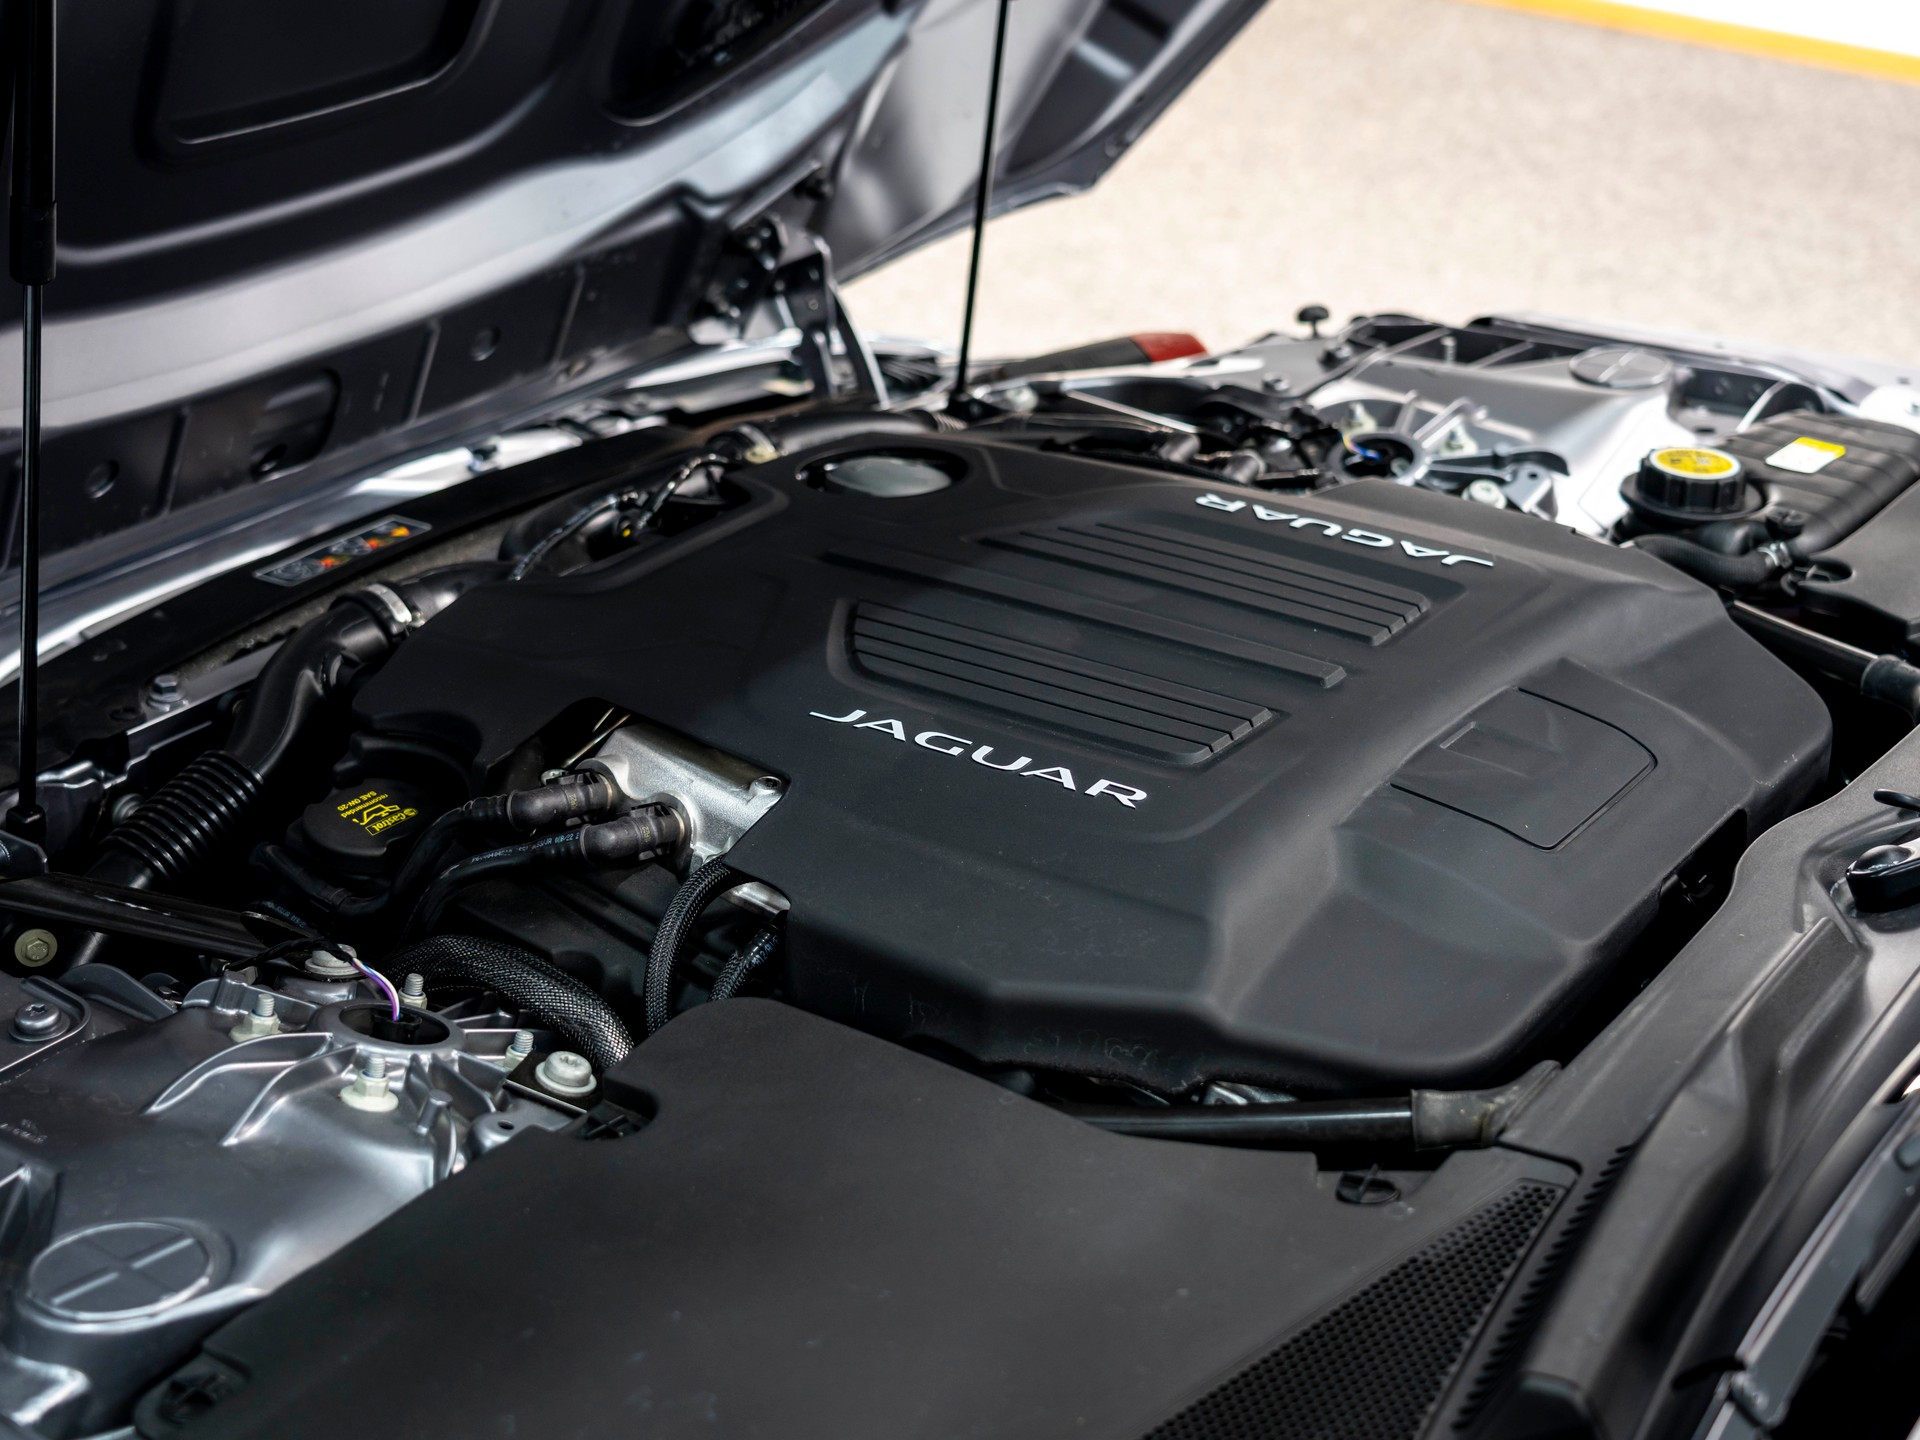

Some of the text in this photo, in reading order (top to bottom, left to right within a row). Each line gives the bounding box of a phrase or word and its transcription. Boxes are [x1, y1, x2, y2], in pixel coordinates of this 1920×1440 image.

[1195, 493, 1494, 567] JAGUAR
[809, 709, 1148, 809] JAGUAR
[341, 793, 389, 818] recommended
[360, 790, 377, 801] SAE
[372, 812, 406, 832] Castrol
